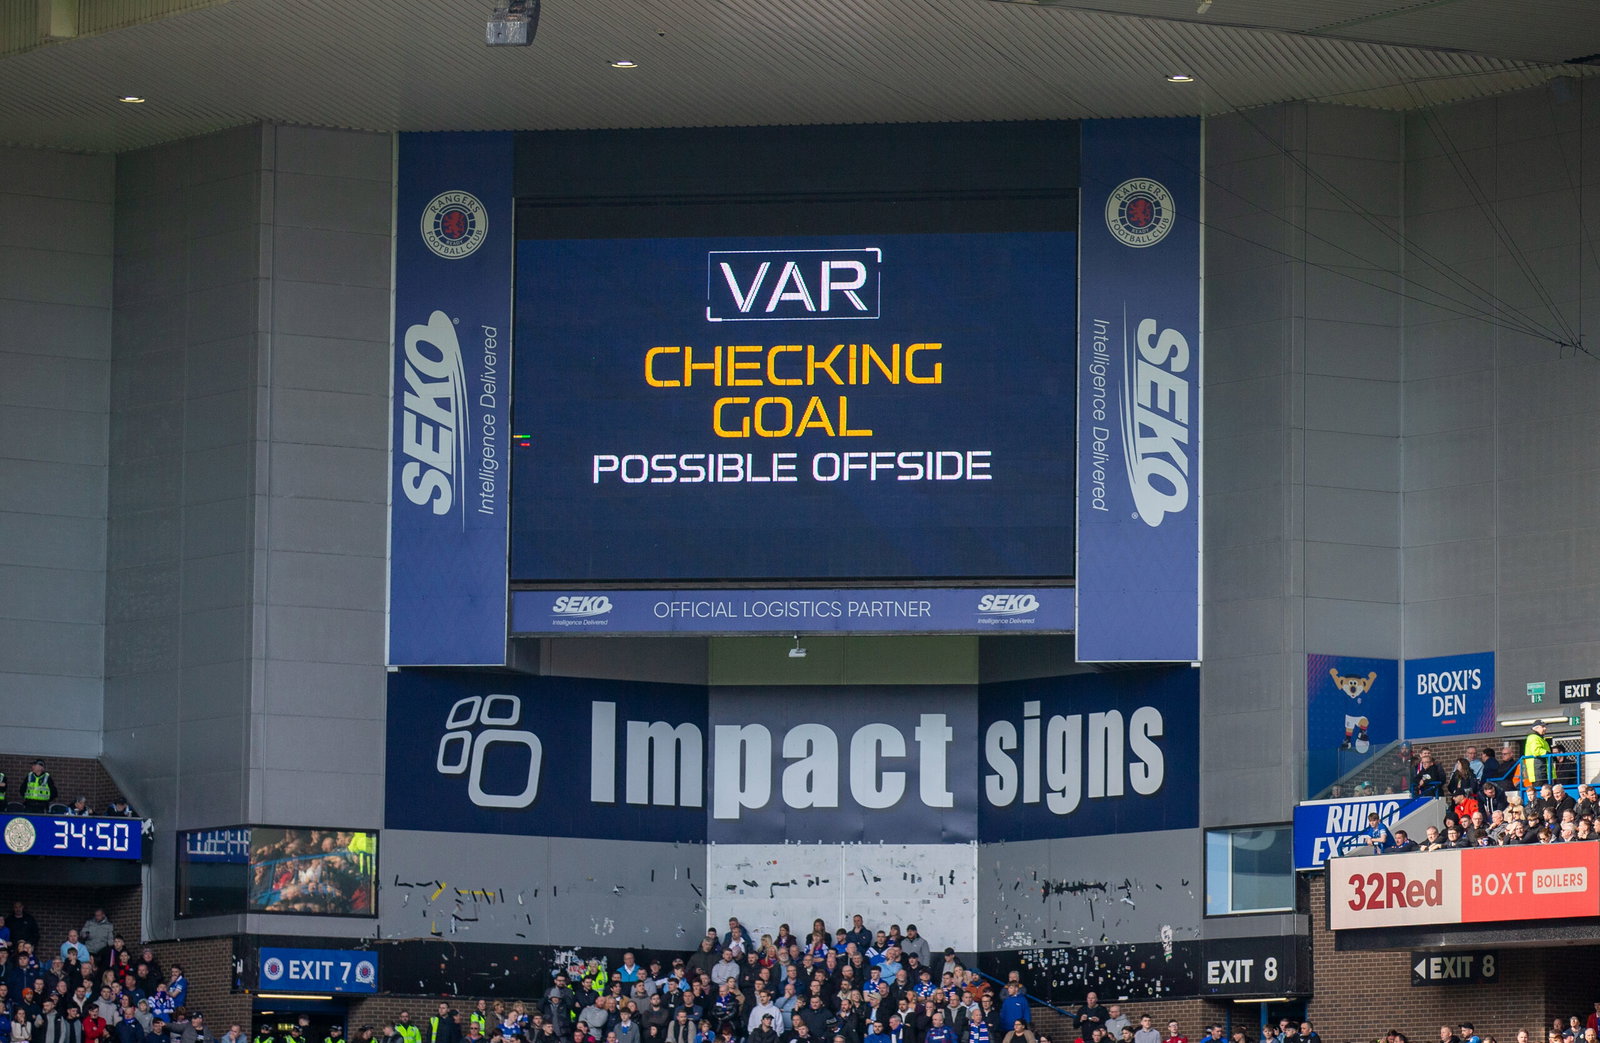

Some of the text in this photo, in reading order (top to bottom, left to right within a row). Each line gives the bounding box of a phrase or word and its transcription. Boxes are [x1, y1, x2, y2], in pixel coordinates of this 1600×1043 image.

[430, 195, 480, 213] RANGERS
[1115, 182, 1167, 201] RANGERS
[427, 230, 482, 254] FOOTBALL CLUB
[1112, 217, 1169, 242] FOOTBALL CLUB
[720, 260, 868, 312] VAR
[644, 343, 942, 387] CHECKING
[402, 310, 461, 515] SEKO
[478, 326, 499, 515] Intelligence Delivered
[713, 396, 873, 438] GOAL
[1089, 318, 1110, 511] Intelligence Delivered
[1134, 318, 1190, 527] SEKO
[593, 450, 992, 483] POSSIBLE OFFSIDE
[552, 596, 613, 614] SEKO
[653, 601, 931, 618] OFFICIAL LOGISTICS PARTNER
[977, 594, 1040, 612] SEKO
[1417, 668, 1481, 695] BROXI'S
[1564, 683, 1591, 698] EXIT
[1432, 693, 1466, 717] DEN
[591, 701, 1164, 819] Impact signs
[53, 820, 129, 852] 34:50
[1348, 869, 1443, 911] 32Red
[1471, 872, 1583, 896] BOXT BOILERS
[288, 960, 334, 981] EXIT
[340, 961, 352, 981] 7
[1207, 957, 1278, 984] EXIT 8
[1429, 954, 1495, 979] EXIT 8
